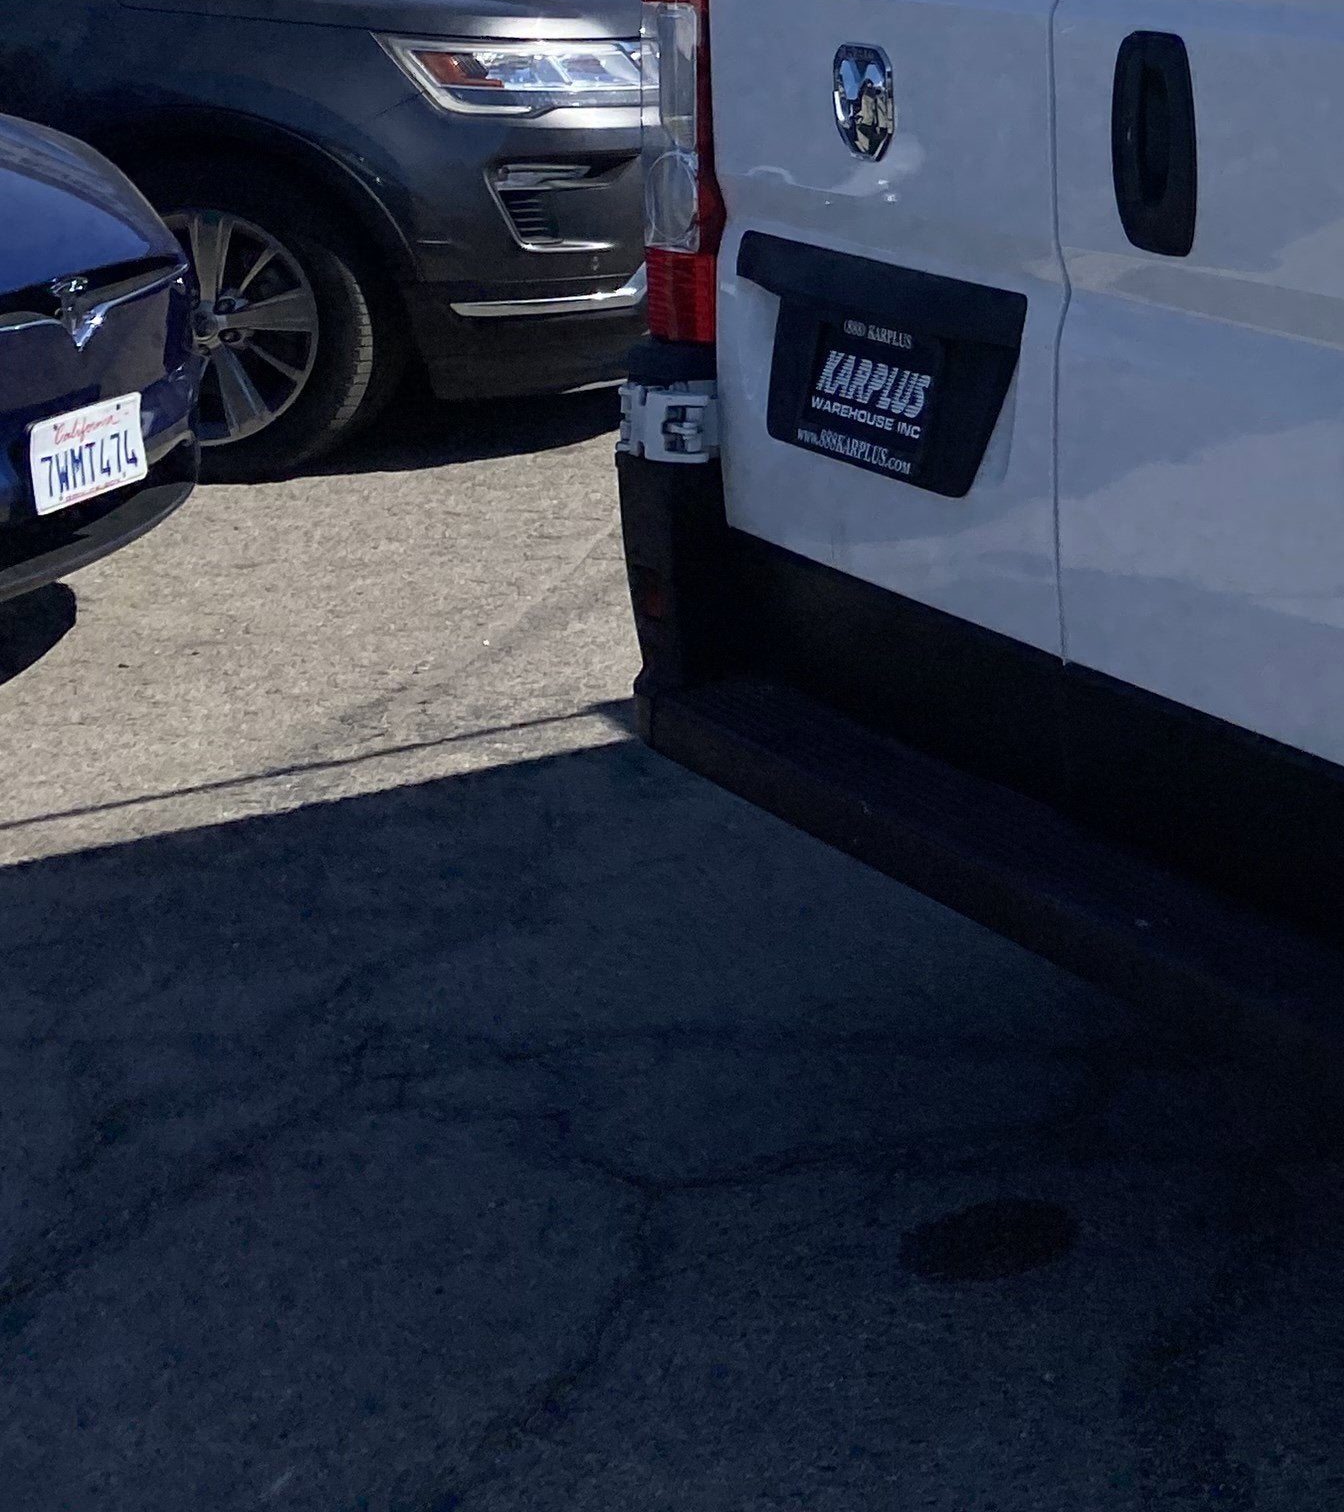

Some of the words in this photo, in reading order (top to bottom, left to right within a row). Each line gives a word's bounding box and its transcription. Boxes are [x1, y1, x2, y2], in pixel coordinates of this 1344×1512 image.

[867, 324, 913, 350] KARPLUS
[815, 349, 932, 419] KARPLUS
[811, 394, 895, 432] WAREHOUSE
[897, 421, 922, 440] INC
[40, 429, 138, 498] 7WMT474
